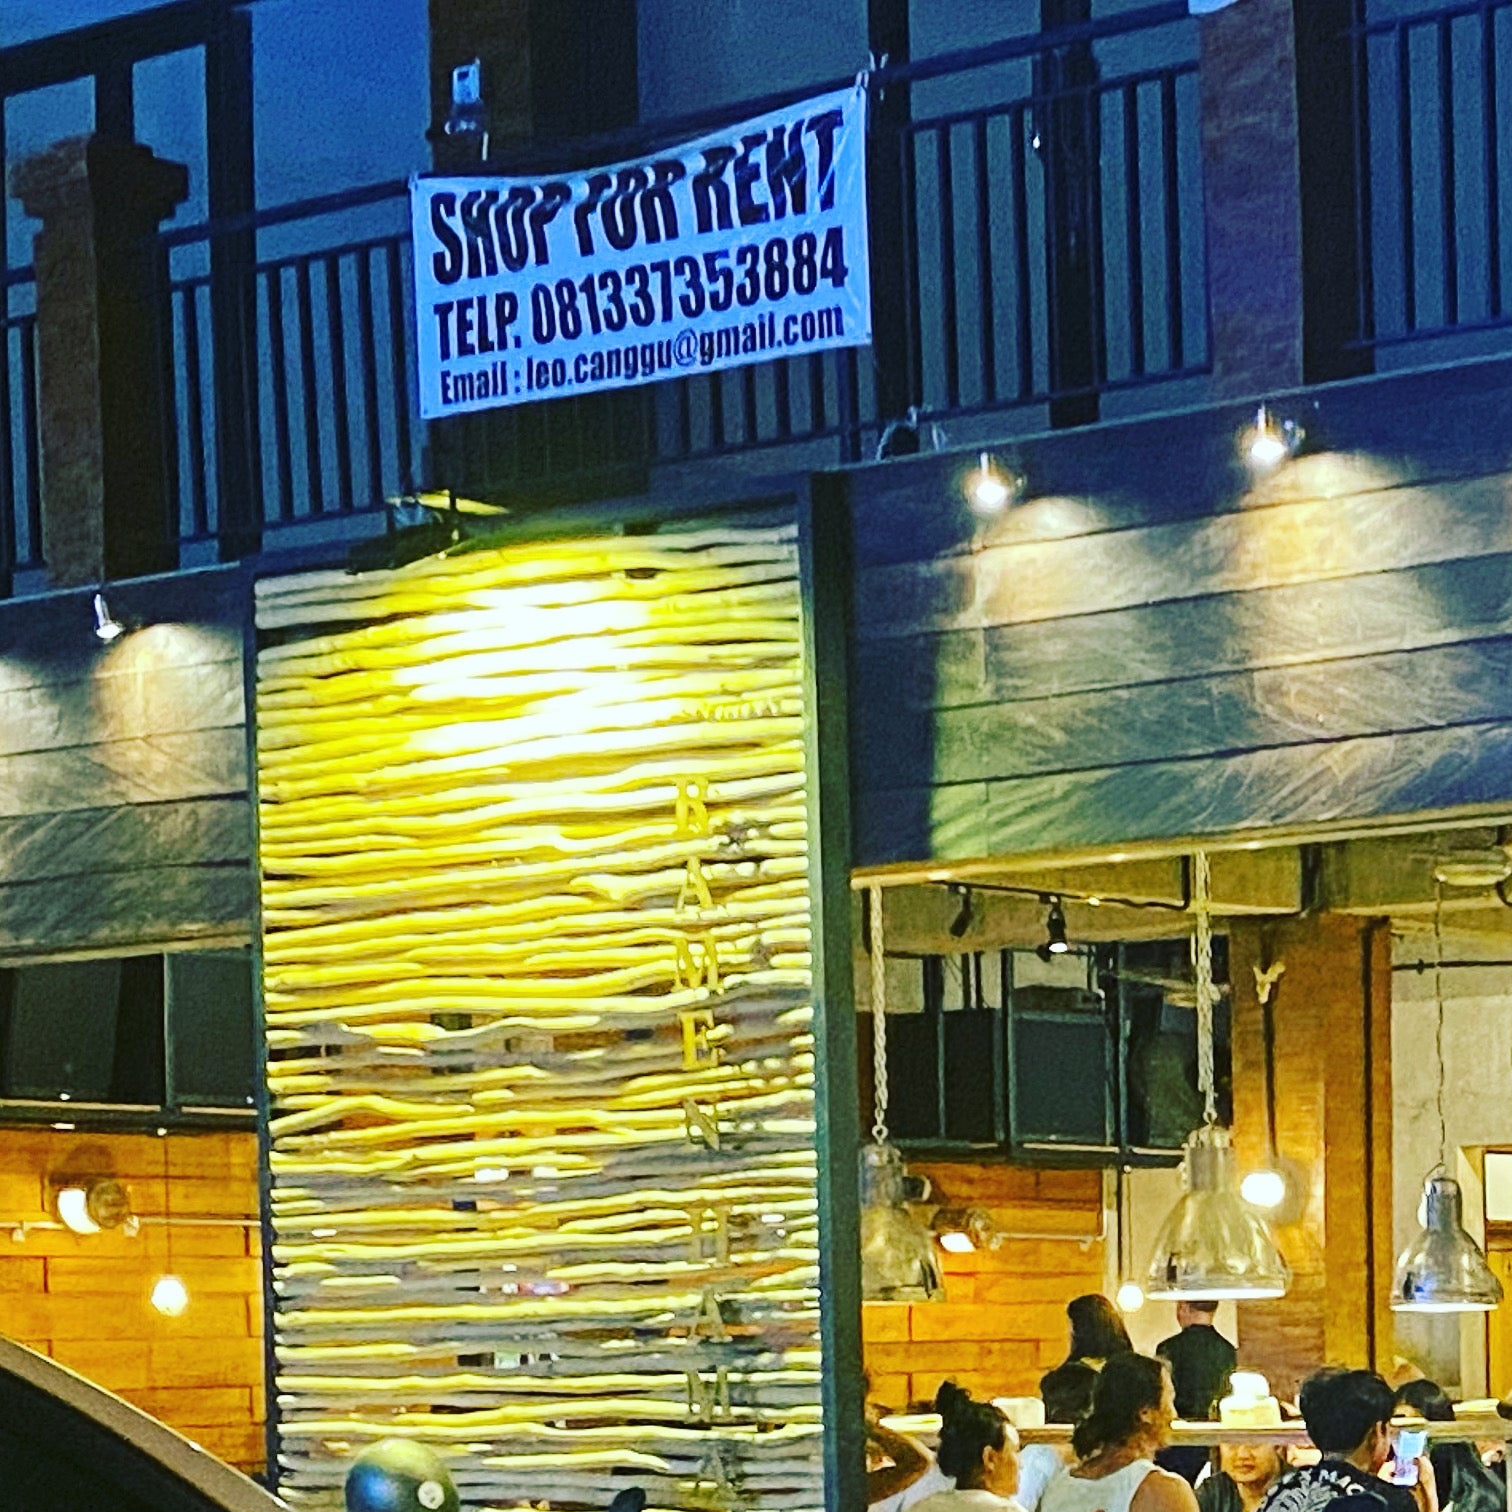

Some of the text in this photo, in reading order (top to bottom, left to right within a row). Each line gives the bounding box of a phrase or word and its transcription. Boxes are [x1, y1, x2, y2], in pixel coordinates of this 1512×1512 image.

[430, 106, 844, 285] SHOP FOR RENT
[433, 226, 848, 362] TELP. 081337353884
[440, 360, 508, 405] Email
[526, 304, 844, 390] leo.canggu@gmail.com
